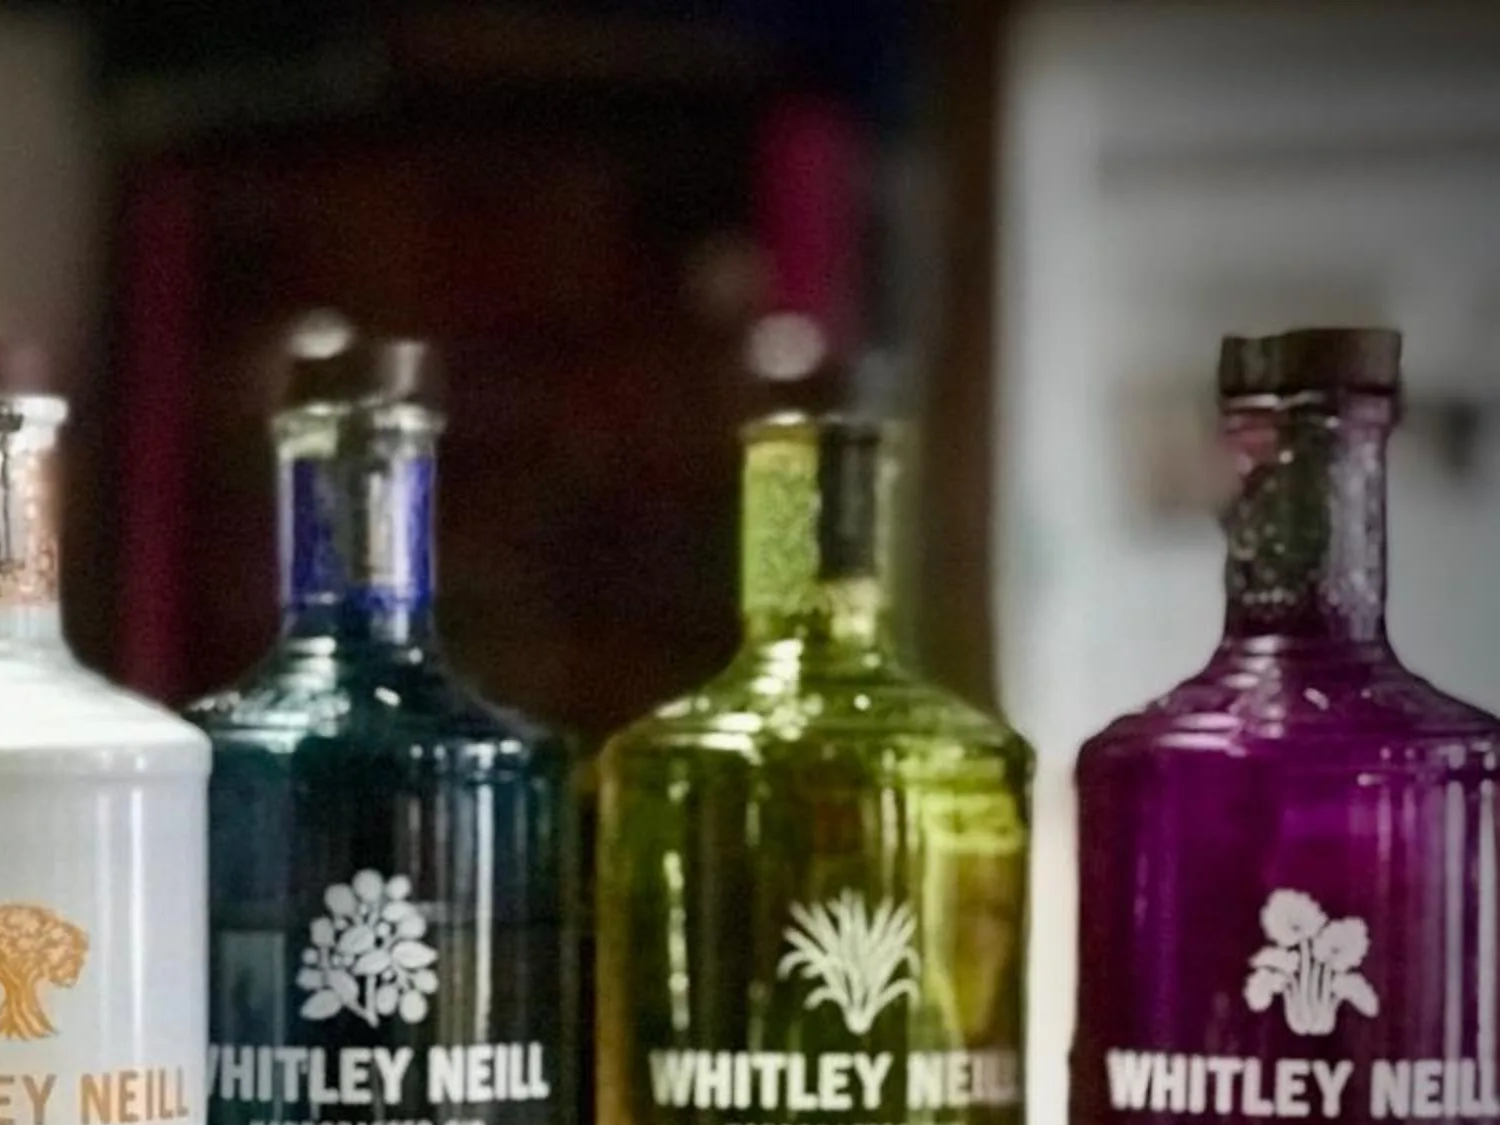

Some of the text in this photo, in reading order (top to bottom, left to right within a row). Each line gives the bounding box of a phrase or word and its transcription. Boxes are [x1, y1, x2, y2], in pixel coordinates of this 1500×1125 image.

[80, 1066, 189, 1125] NEILL
[428, 1041, 550, 1103] NEILL
[649, 1049, 1019, 1111] WHITLEY NEILL
[1107, 1047, 1500, 1119] WHITLEY NEILL
